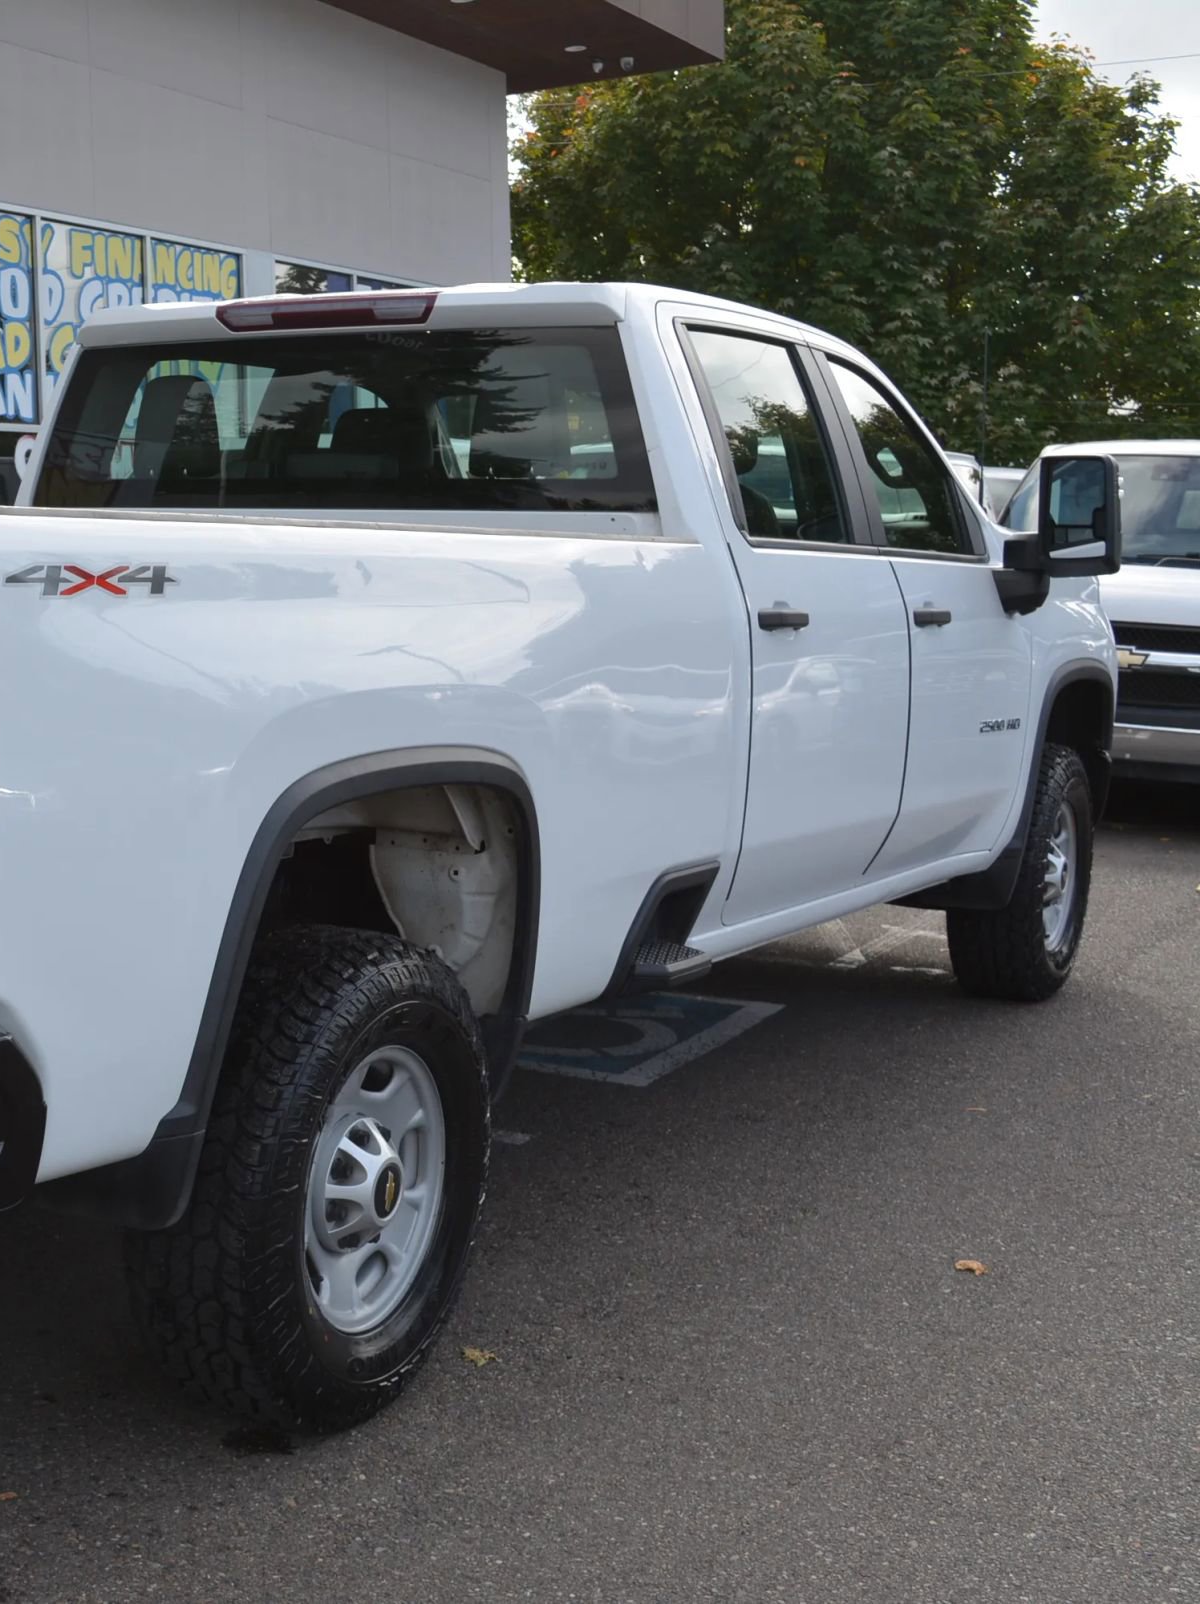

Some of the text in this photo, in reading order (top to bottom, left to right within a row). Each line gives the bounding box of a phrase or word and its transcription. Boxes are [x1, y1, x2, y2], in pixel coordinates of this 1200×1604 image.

[69, 228, 239, 299] FINANCING
[980, 718, 1021, 733] 2500 HD
